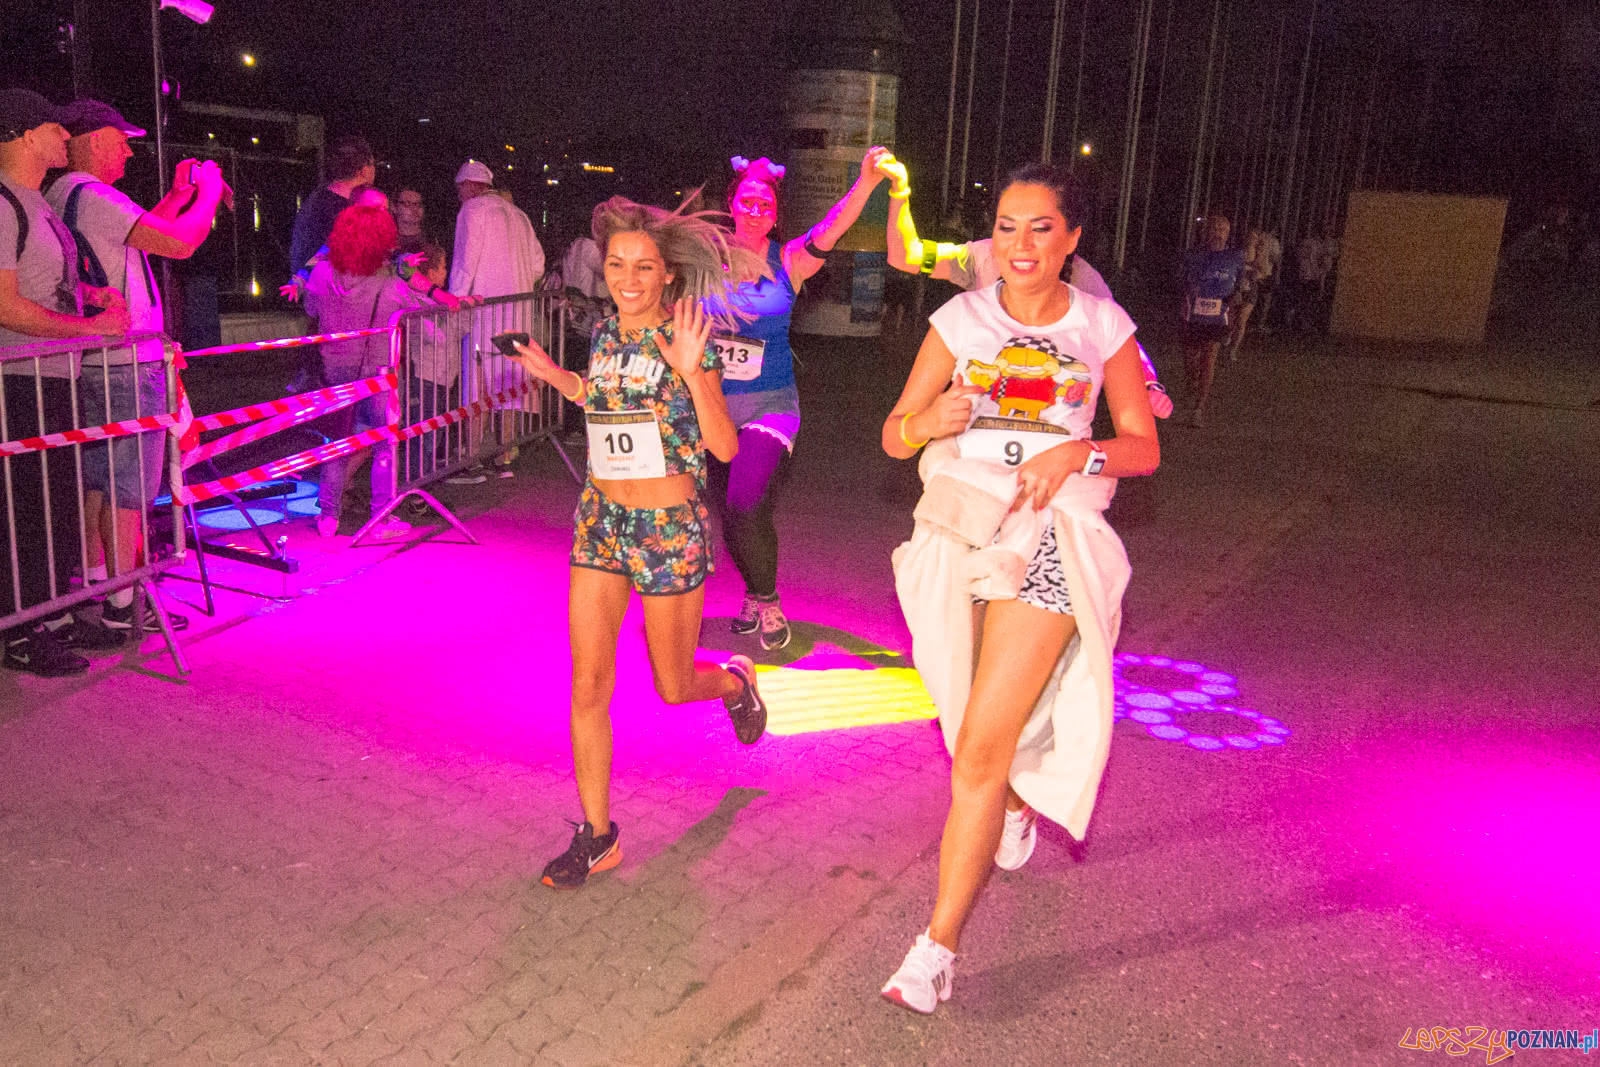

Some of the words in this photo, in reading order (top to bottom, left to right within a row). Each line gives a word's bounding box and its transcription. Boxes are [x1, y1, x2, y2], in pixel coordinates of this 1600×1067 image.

[589, 353, 665, 385] MALIBU
[604, 432, 634, 454] 10
[1004, 441, 1024, 466] 9
